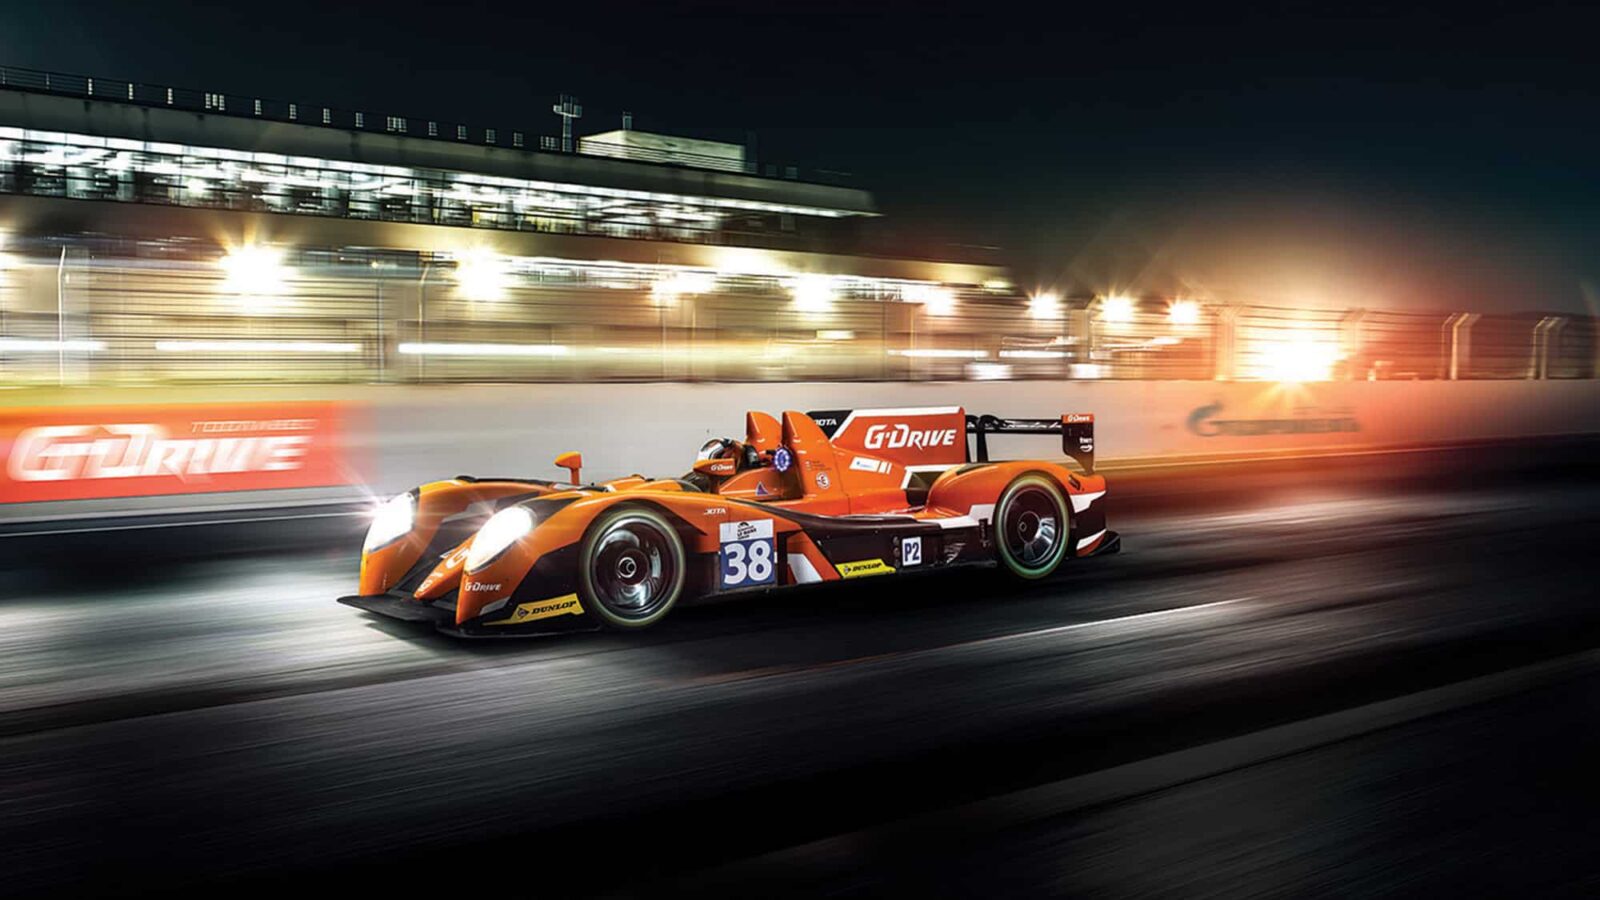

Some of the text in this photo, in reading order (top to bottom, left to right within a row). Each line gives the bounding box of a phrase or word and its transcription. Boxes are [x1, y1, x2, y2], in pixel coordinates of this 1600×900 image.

[904, 542, 920, 562] P2
[724, 540, 772, 584] 38
[852, 562, 882, 572] DUNLOP
[531, 600, 577, 615] DUNLOP
